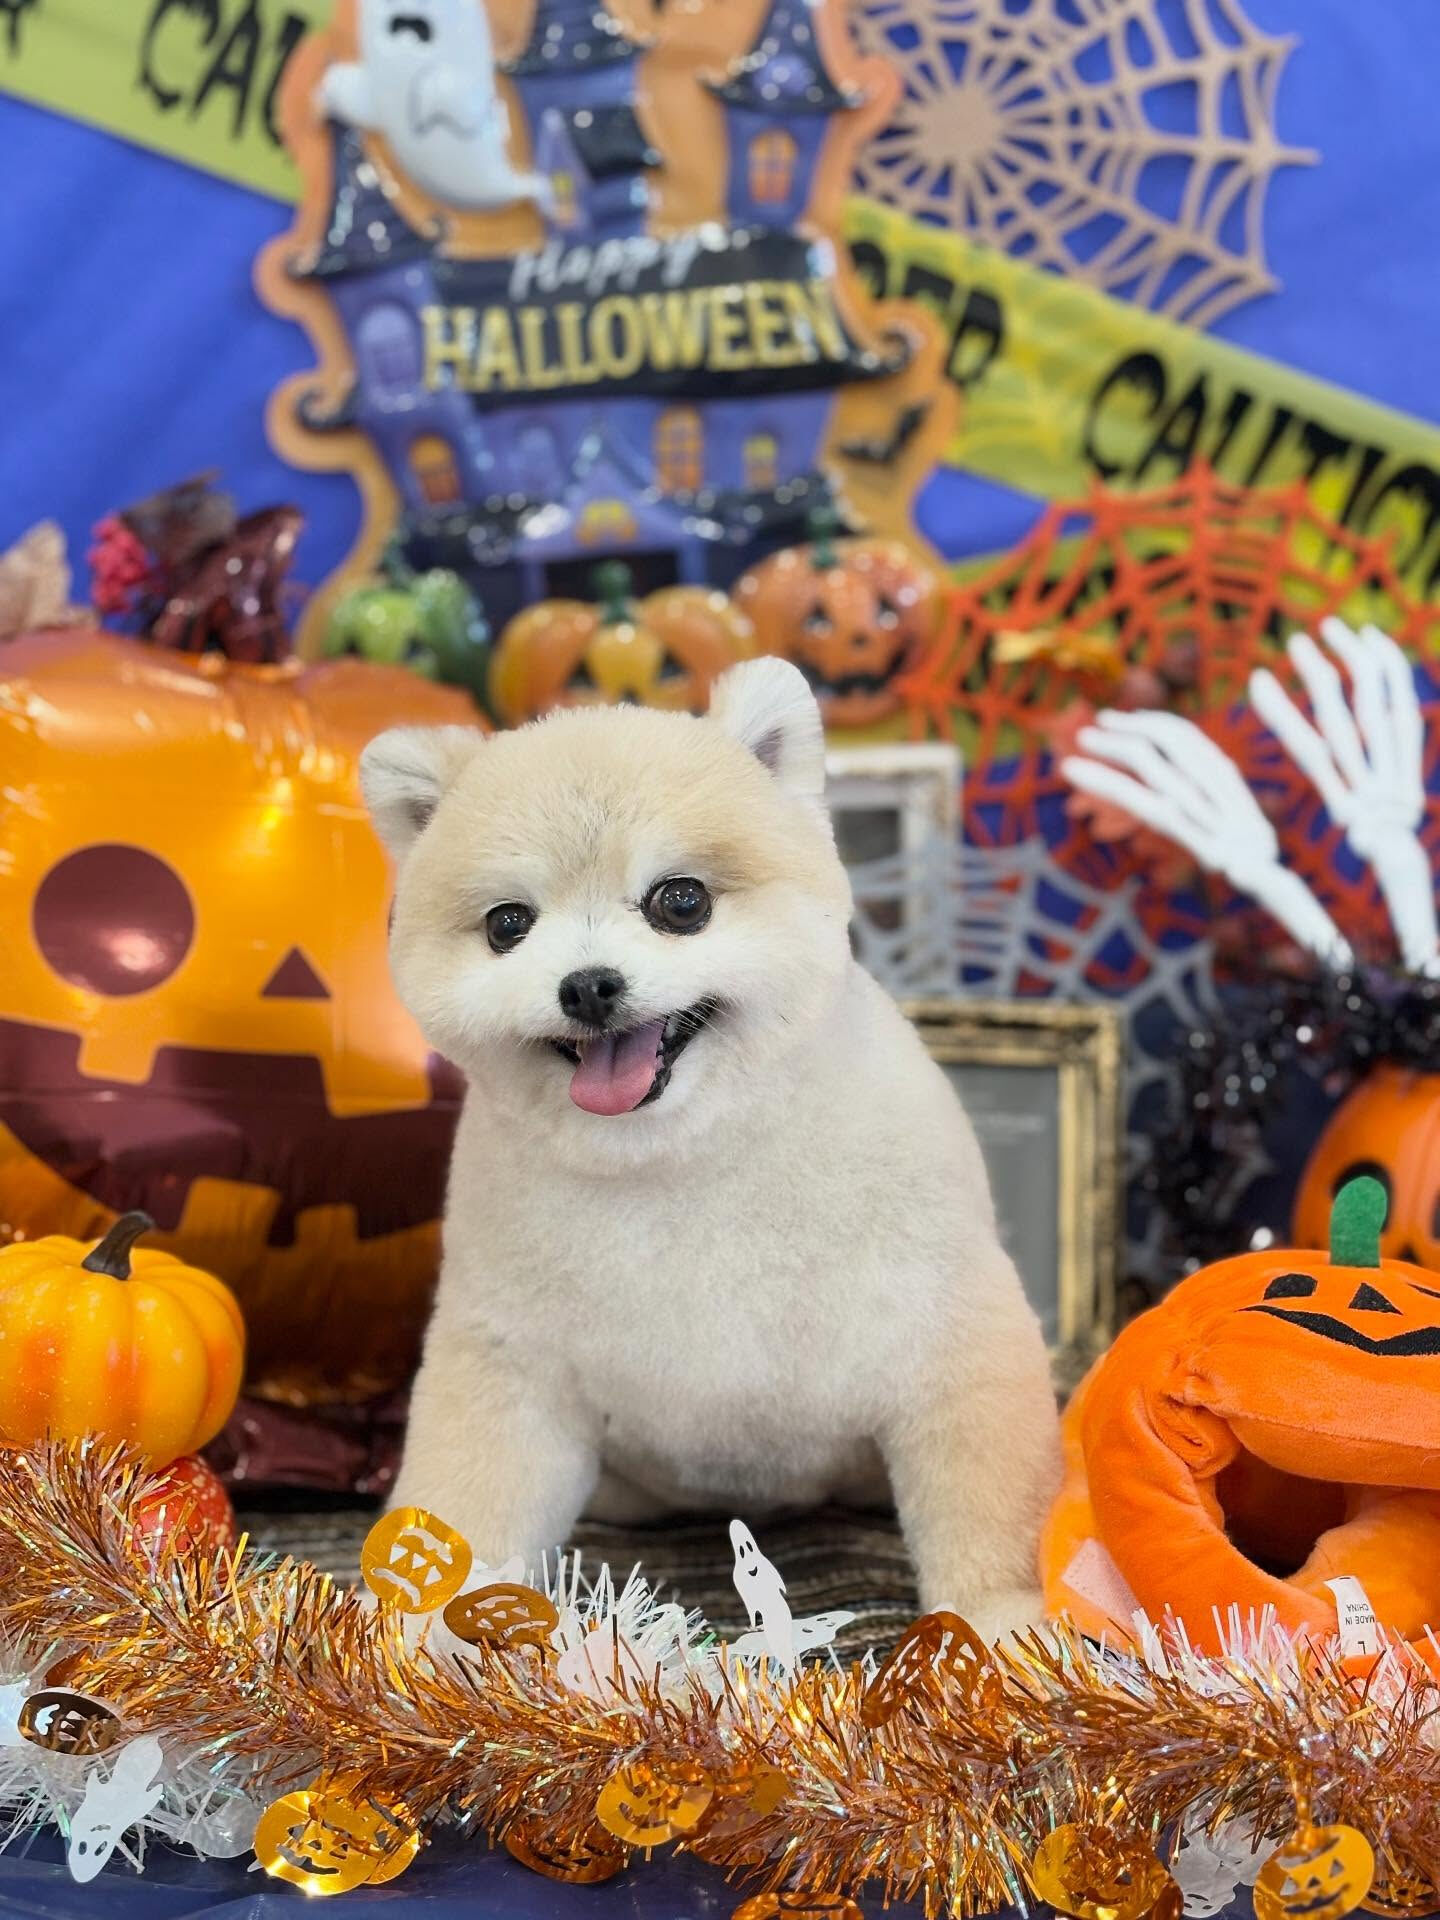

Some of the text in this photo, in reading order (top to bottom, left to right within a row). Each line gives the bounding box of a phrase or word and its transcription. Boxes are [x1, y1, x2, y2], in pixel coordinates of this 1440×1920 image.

[508, 222, 728, 300] Happy
[421, 280, 849, 393] HALLOWEEN
[1083, 350, 1440, 602] CAUTIO
[1345, 1614, 1375, 1625] MADE IN
[1346, 1603, 1369, 1612] CHINA
